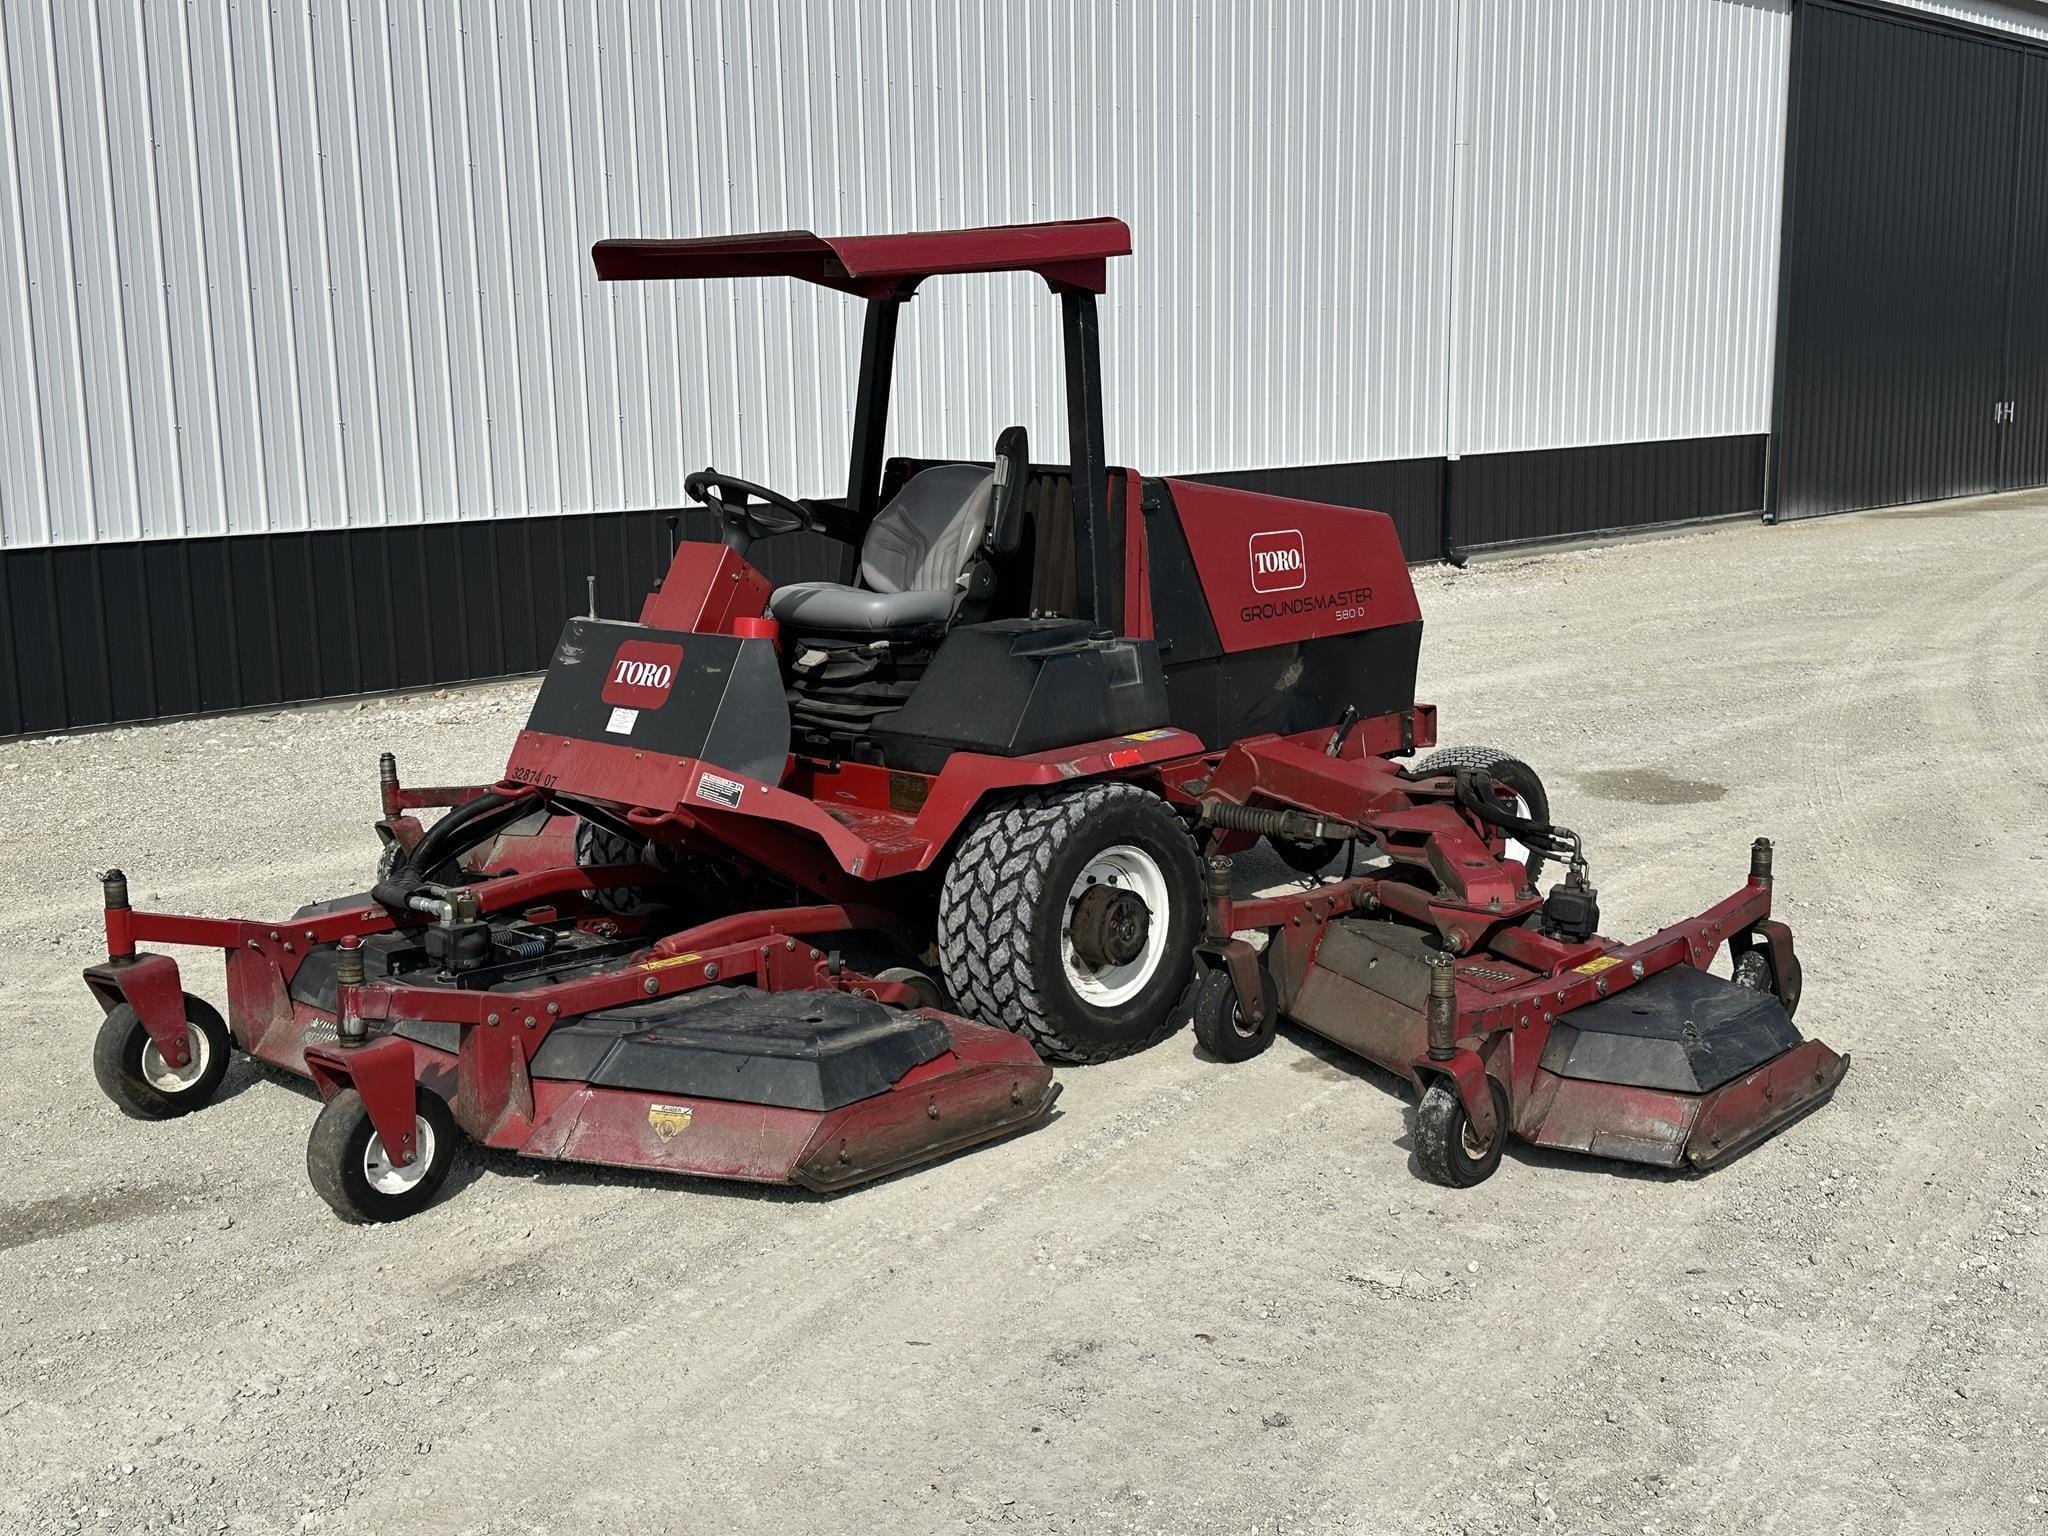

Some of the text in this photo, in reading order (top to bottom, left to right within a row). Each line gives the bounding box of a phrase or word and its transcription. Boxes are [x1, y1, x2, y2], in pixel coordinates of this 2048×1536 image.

[1254, 548, 1301, 574] TORO
[1240, 587, 1373, 622] GROUNDSMASTER
[1335, 607, 1365, 621] 580 D
[614, 660, 671, 688] TORO
[512, 767, 558, 787] 32874 07
